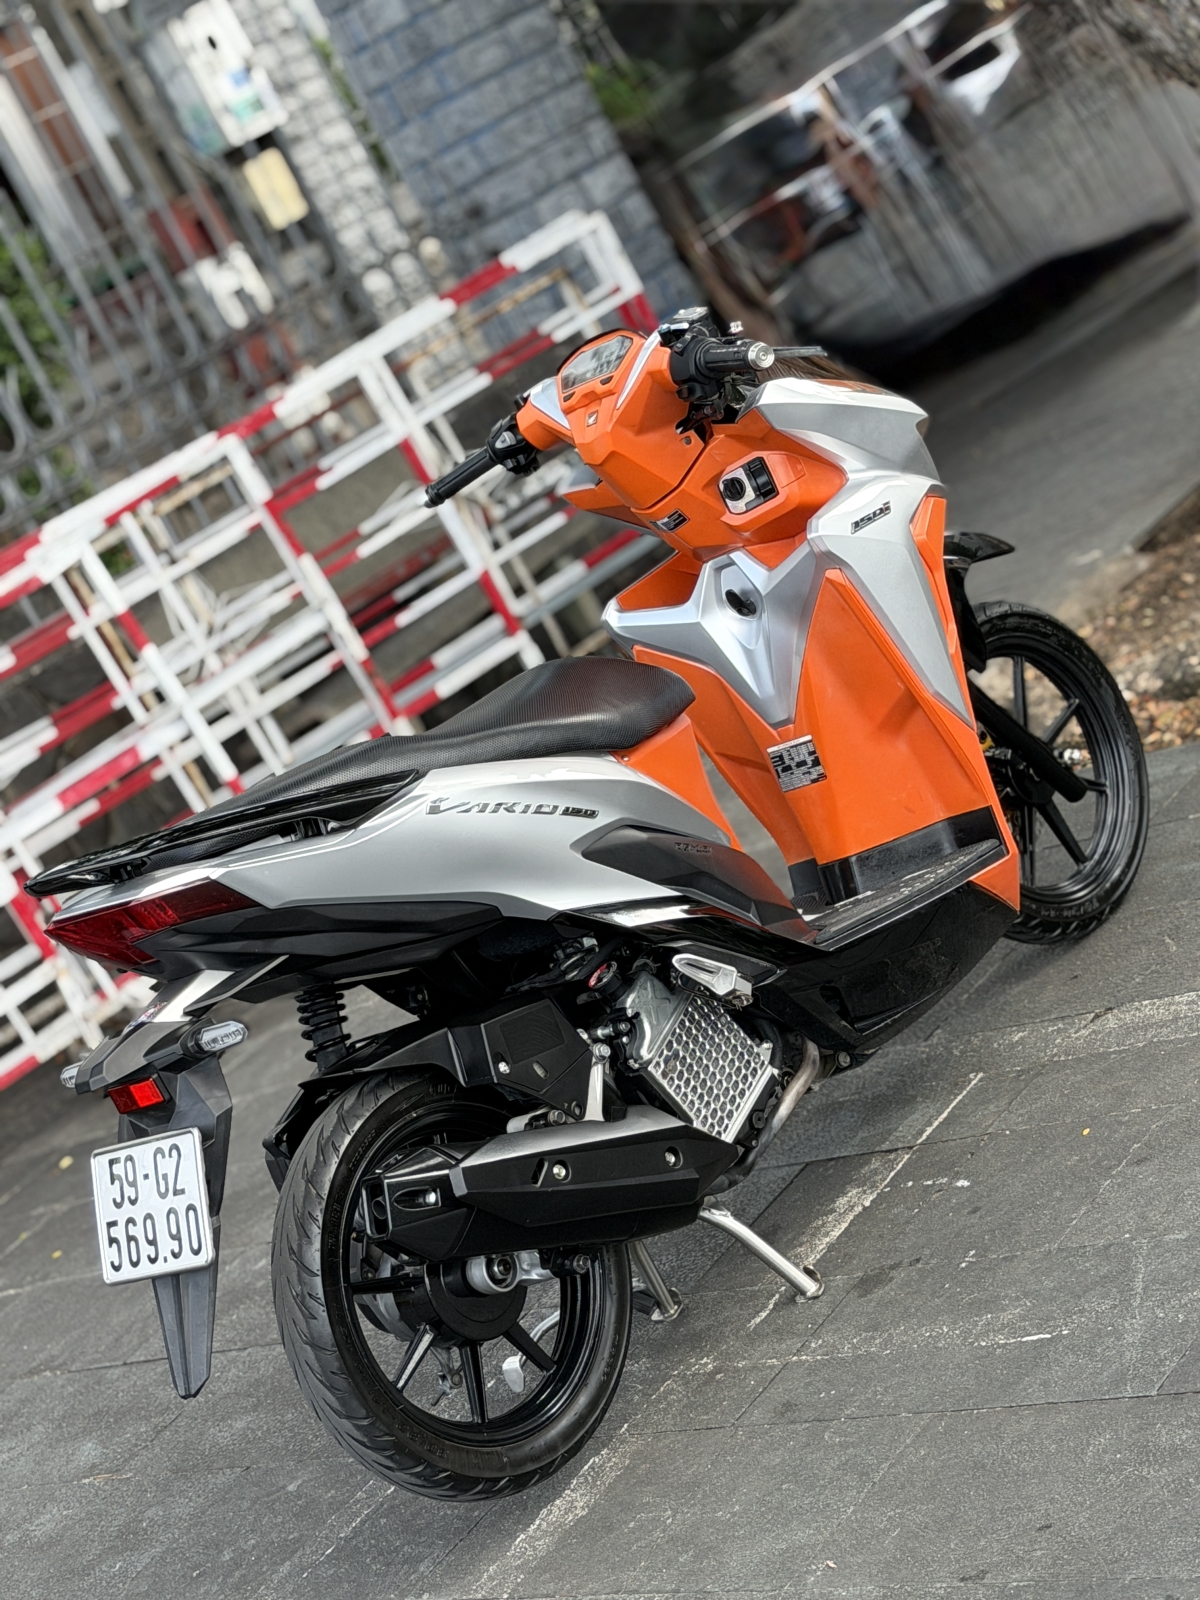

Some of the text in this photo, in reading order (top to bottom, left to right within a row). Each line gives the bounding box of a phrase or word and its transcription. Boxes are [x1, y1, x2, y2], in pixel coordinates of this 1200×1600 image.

[425, 797, 560, 815] VARIO
[108, 1143, 186, 1209] 59-G2
[106, 1203, 203, 1272] 569.90
